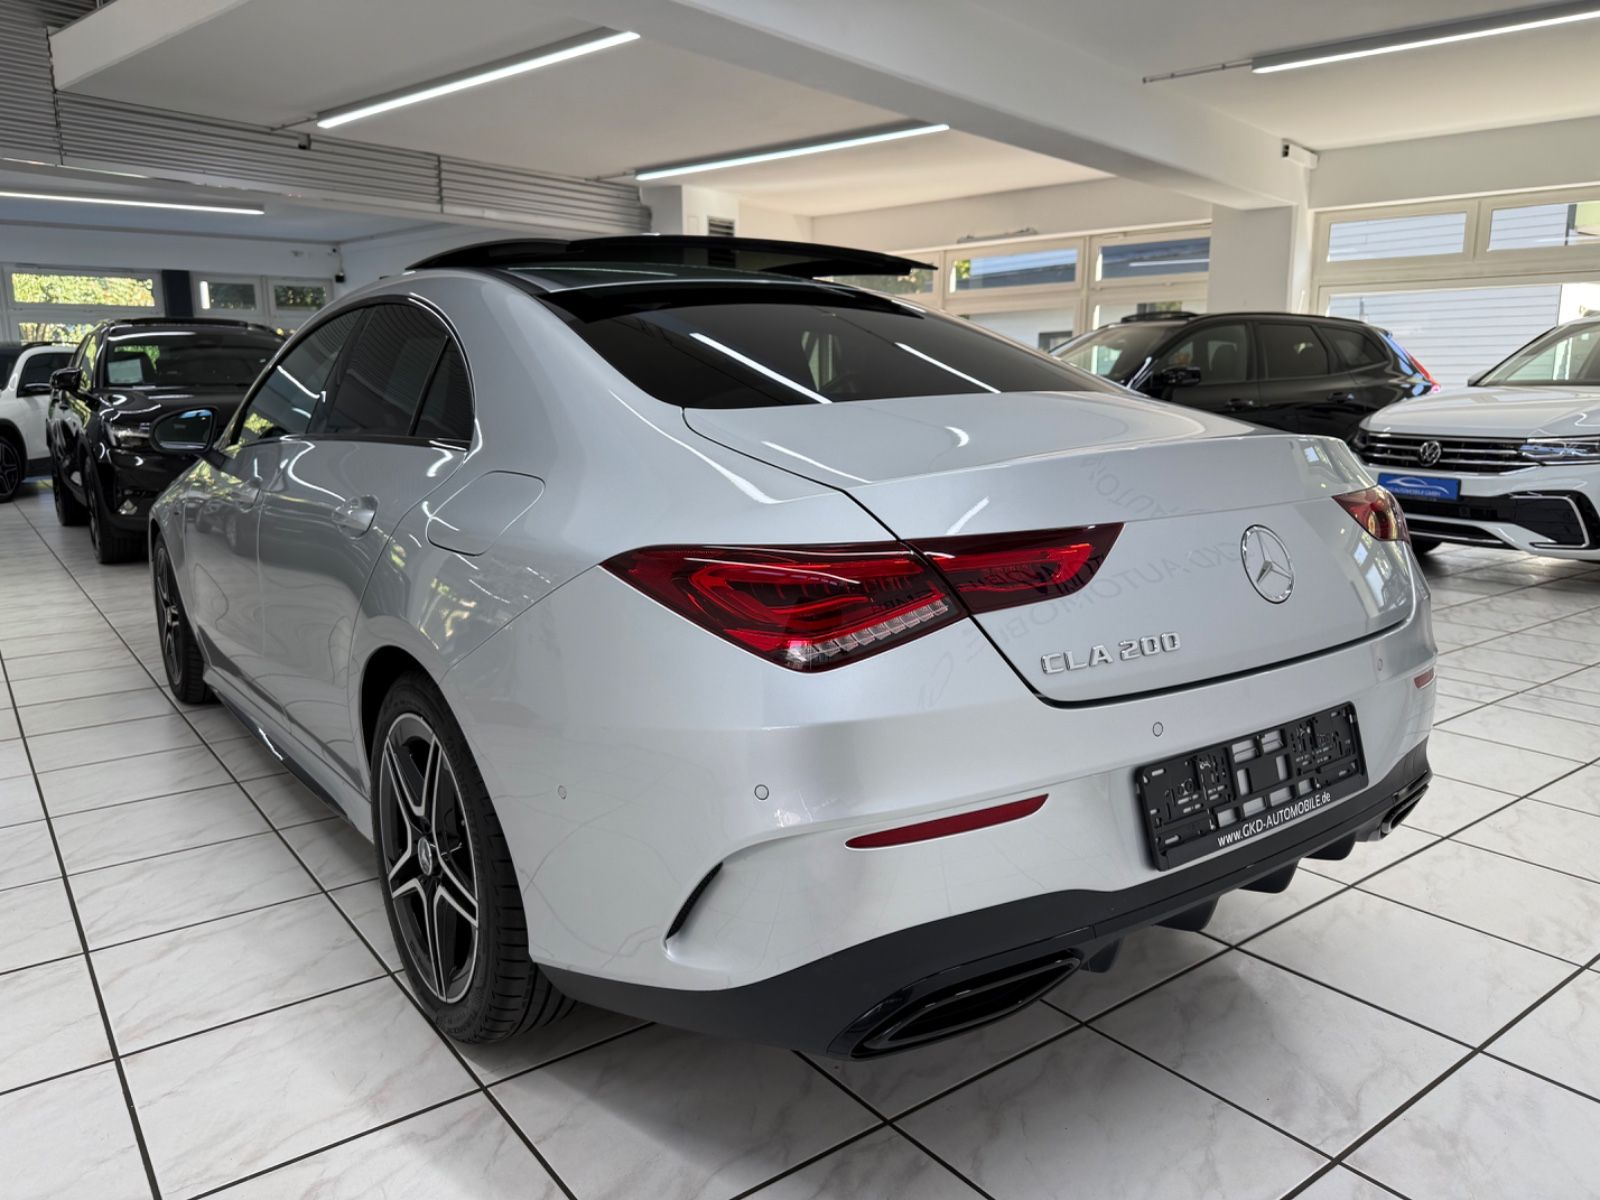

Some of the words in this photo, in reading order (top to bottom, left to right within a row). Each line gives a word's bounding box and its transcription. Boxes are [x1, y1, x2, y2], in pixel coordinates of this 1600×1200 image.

[1041, 644, 1114, 674] CLA
[1118, 631, 1181, 661] 200
[1217, 791, 1331, 847] www.GKD-AUTOMOBILE.de
